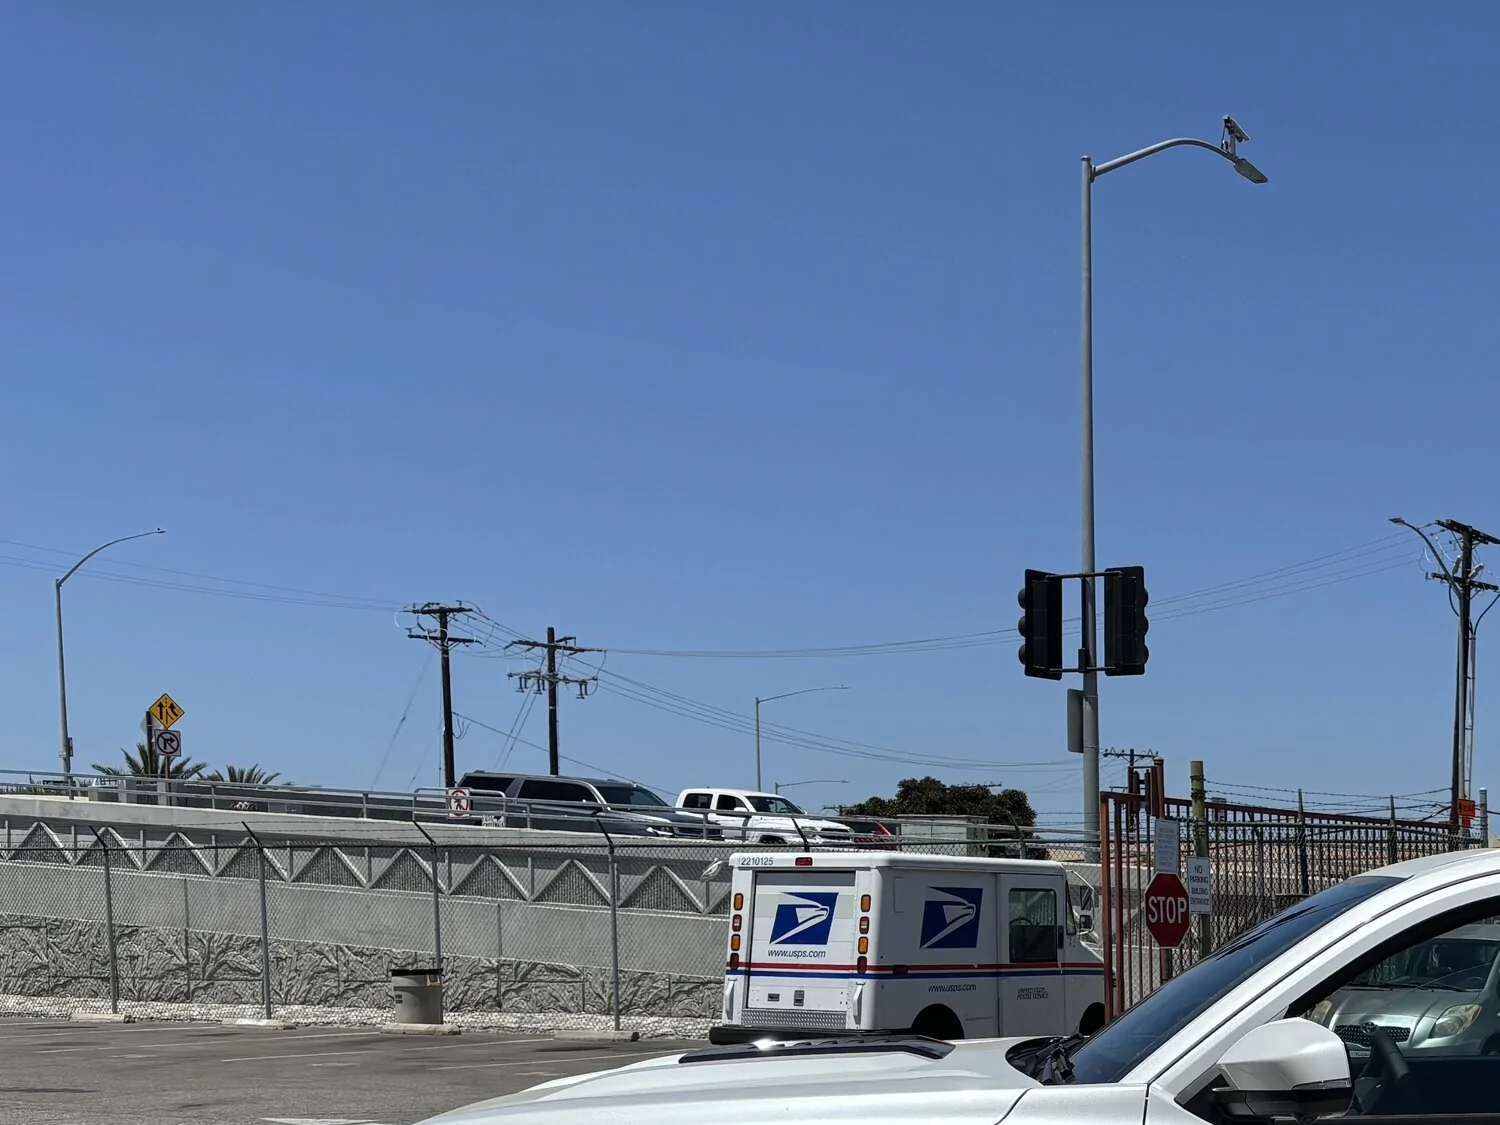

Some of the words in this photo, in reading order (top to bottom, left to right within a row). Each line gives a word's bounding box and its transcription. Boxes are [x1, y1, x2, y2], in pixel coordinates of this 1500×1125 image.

[741, 857, 774, 865] 2210125
[1194, 865, 1203, 874] NO
[1148, 896, 1187, 924] STOP
[768, 949, 826, 958] www.usps.com
[928, 983, 976, 992] www.usps.com
